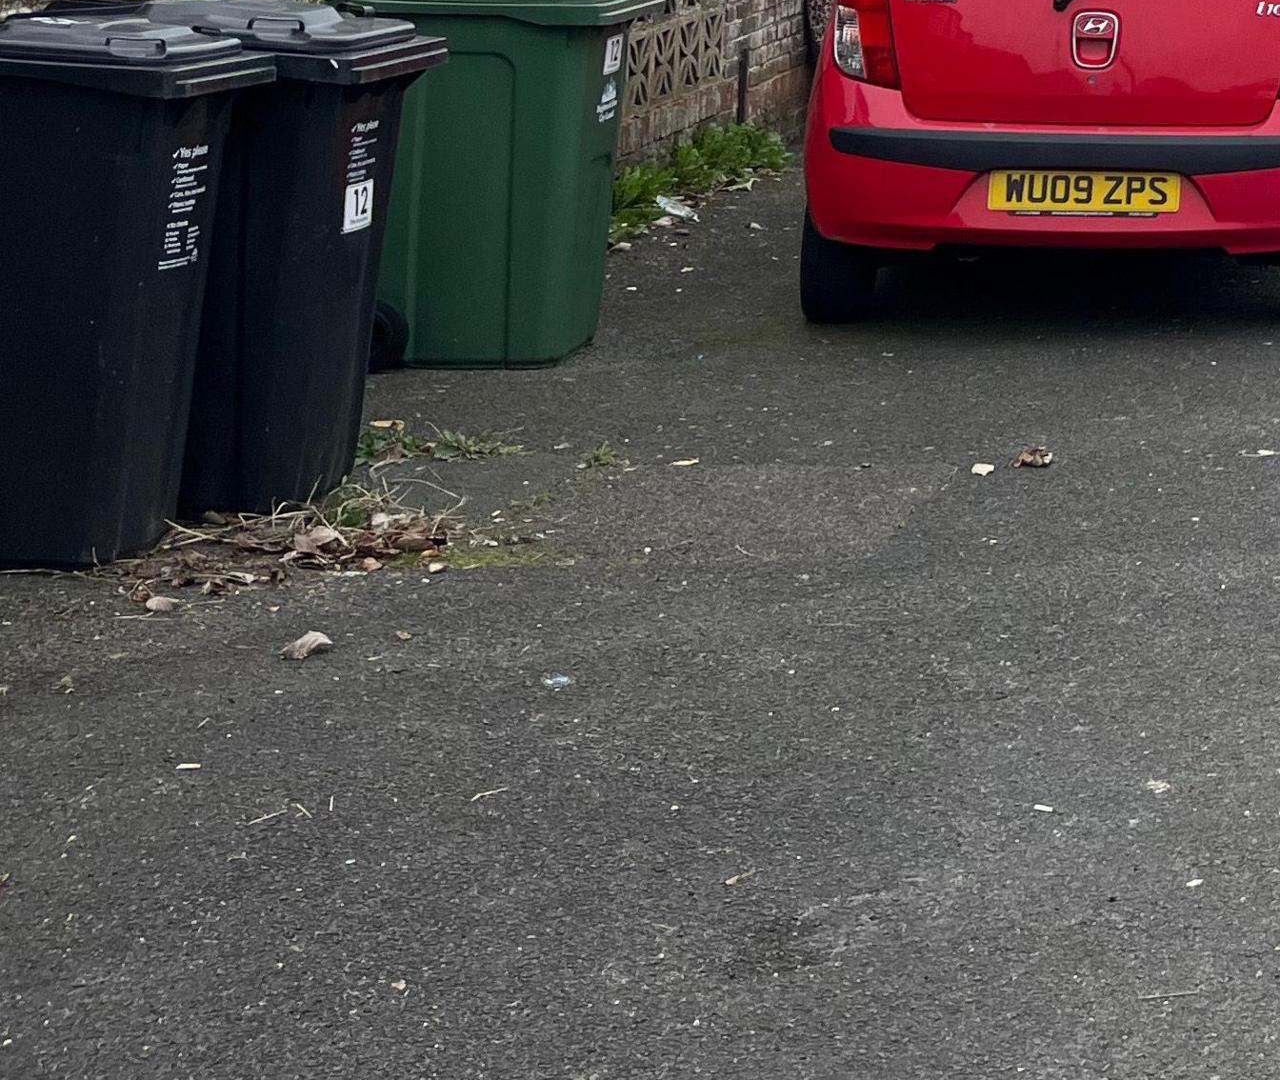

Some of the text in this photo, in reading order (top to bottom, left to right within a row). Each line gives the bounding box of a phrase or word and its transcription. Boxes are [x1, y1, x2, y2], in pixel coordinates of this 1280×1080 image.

[609, 39, 621, 63] 12
[353, 186, 369, 217] 12
[1006, 173, 1169, 205] WU09 ZPS
